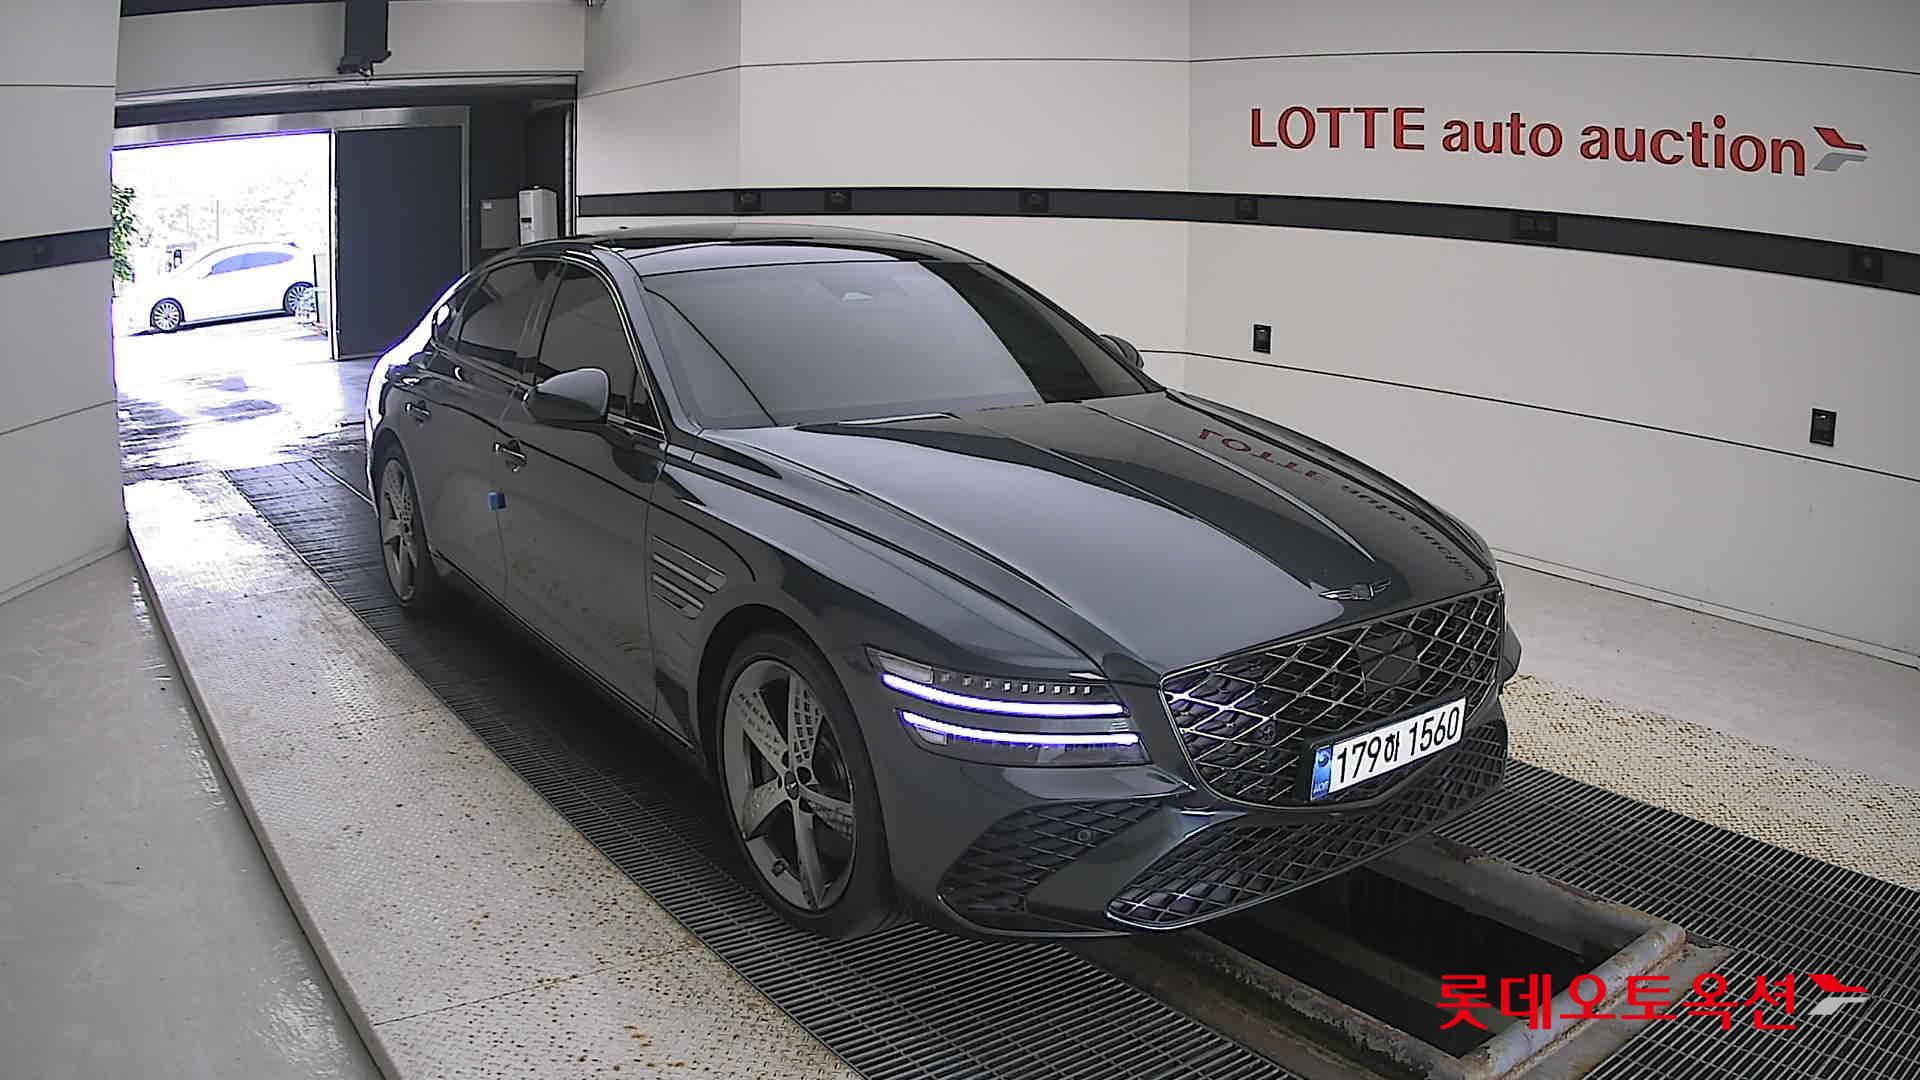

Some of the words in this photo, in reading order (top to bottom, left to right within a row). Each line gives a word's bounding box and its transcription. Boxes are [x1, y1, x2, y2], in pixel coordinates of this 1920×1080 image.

[1250, 107, 1424, 150] LOTTE
[1442, 113, 1563, 157] auto
[1579, 115, 1806, 176] auction
[1336, 731, 1400, 784] 179하
[1409, 706, 1460, 757] 1560
